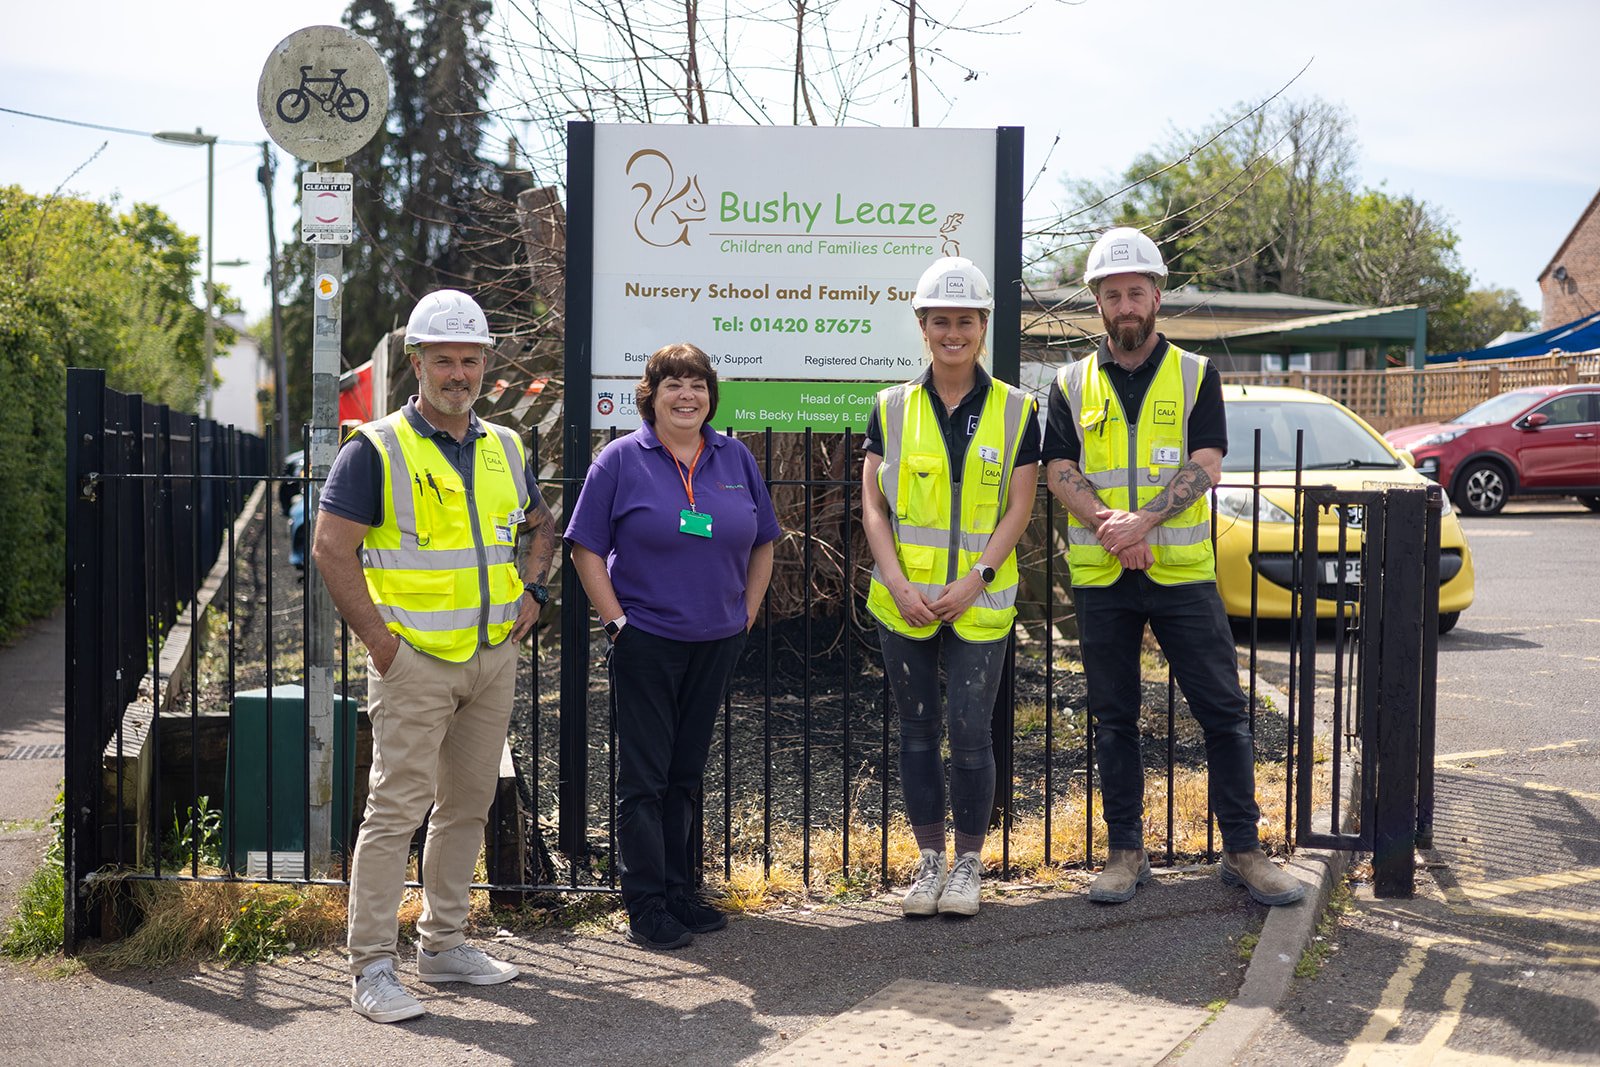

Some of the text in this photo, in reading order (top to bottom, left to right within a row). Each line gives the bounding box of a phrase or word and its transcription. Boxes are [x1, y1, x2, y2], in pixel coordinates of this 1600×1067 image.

[720, 191, 937, 233] Bushy Leaze
[720, 239, 934, 255] Children and Families Centre
[625, 282, 702, 303] Nursery
[708, 283, 769, 299] School
[776, 284, 812, 300] and
[818, 285, 880, 305] Family
[712, 316, 872, 334] Tel: 01420 87675
[624, 352, 652, 362] Bush
[724, 354, 763, 366] Support
[804, 355, 857, 367] Registered
[859, 356, 894, 368] Charity
[896, 357, 914, 366] No.
[800, 393, 876, 405] Head of Cent
[735, 409, 756, 419] Mrs
[759, 410, 794, 422] Becky
[797, 411, 840, 424] Hussey
[842, 413, 852, 421] B.
[985, 469, 1001, 477] CALA
